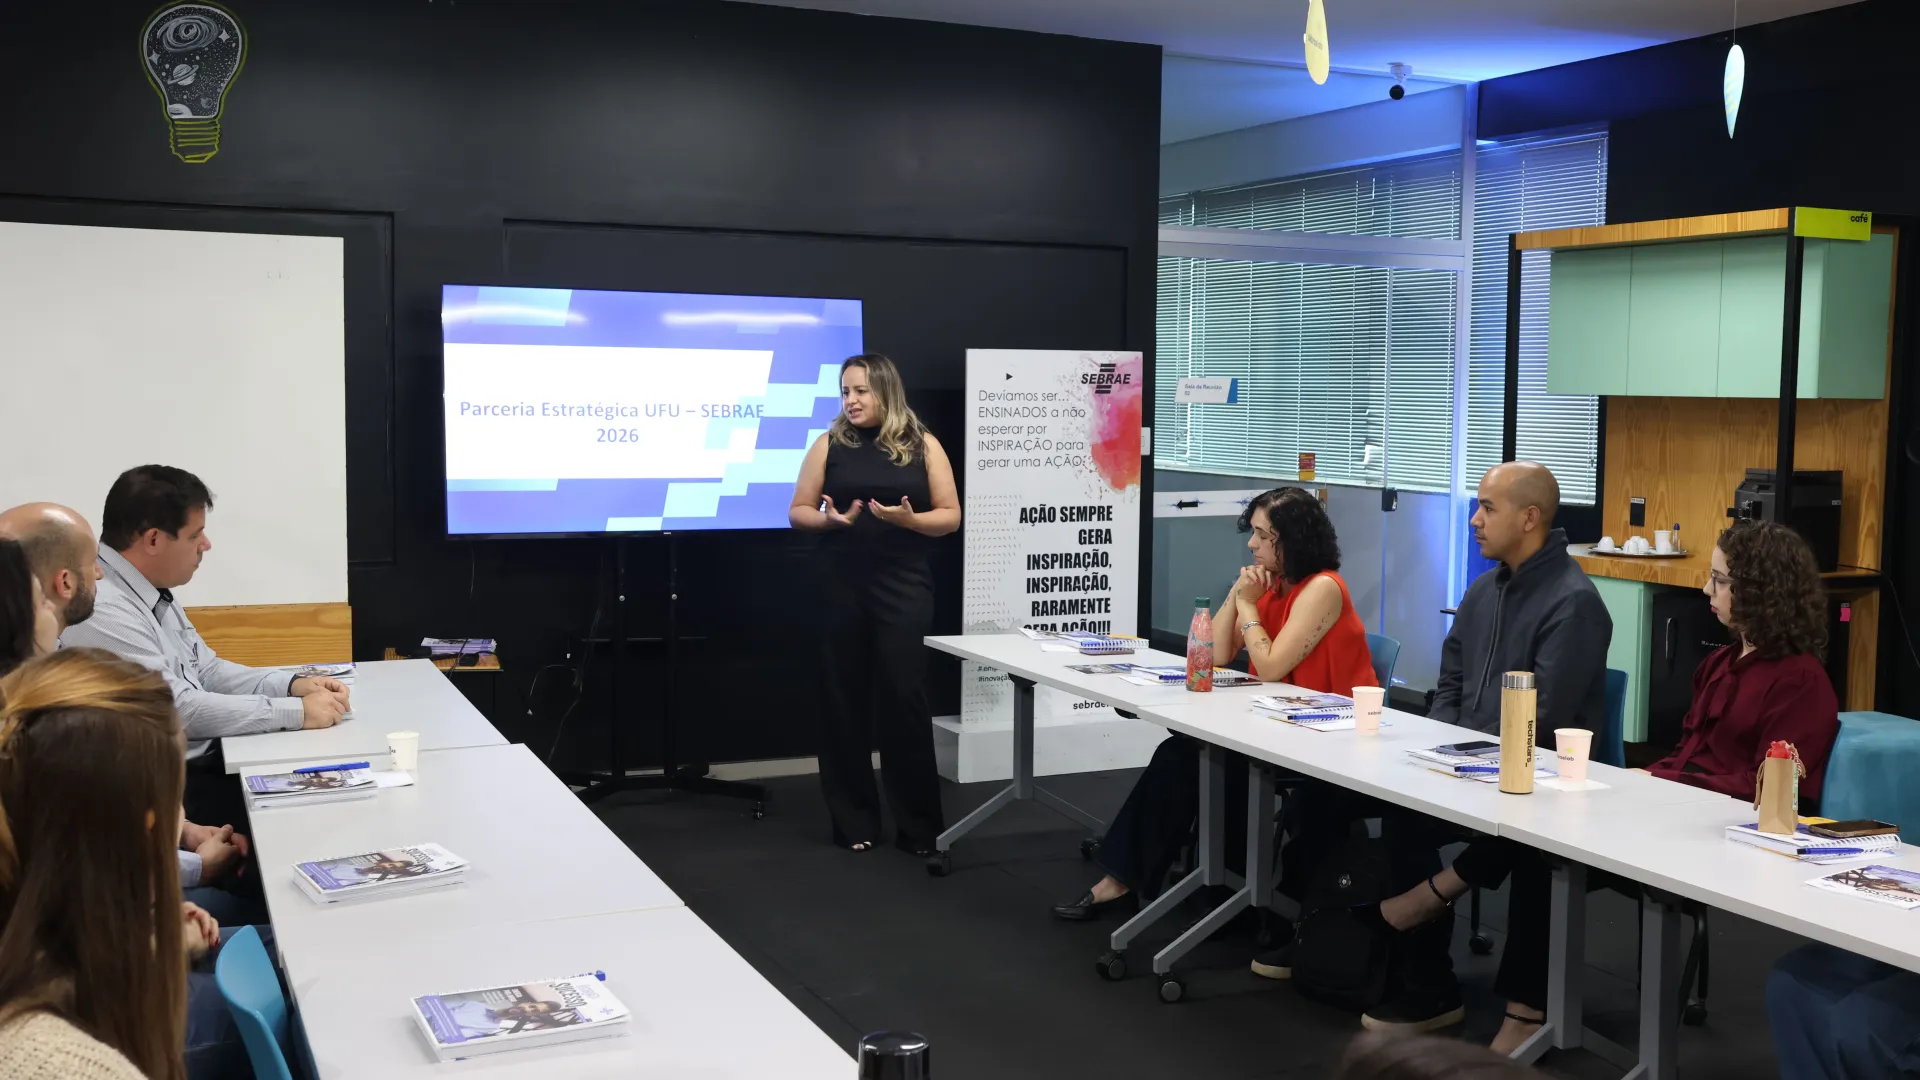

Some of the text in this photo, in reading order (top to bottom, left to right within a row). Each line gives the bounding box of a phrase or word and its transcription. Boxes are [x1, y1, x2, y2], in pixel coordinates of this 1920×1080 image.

[1850, 213, 1868, 223] café
[1081, 373, 1131, 384] SEBRAE
[460, 401, 535, 416] Parceria
[541, 402, 638, 421] Estratégica
[645, 403, 680, 417] UFU
[701, 404, 764, 418] SEBRAE
[978, 406, 1086, 418] ENSINADOS a não
[597, 428, 639, 443] 2026
[978, 424, 1047, 436] esperar por
[978, 438, 1084, 453] INSPIRAÇÃO para
[978, 458, 1010, 470] gerar
[1014, 457, 1040, 467] uma
[1019, 504, 1113, 526] AÇÃO SEMPRE
[1078, 529, 1113, 545] GERA
[1027, 549, 1112, 571] INSPIRAÇÃO,
[1027, 572, 1112, 594] INSPIRAÇÃO,
[1031, 598, 1111, 617] RARAMENTE
